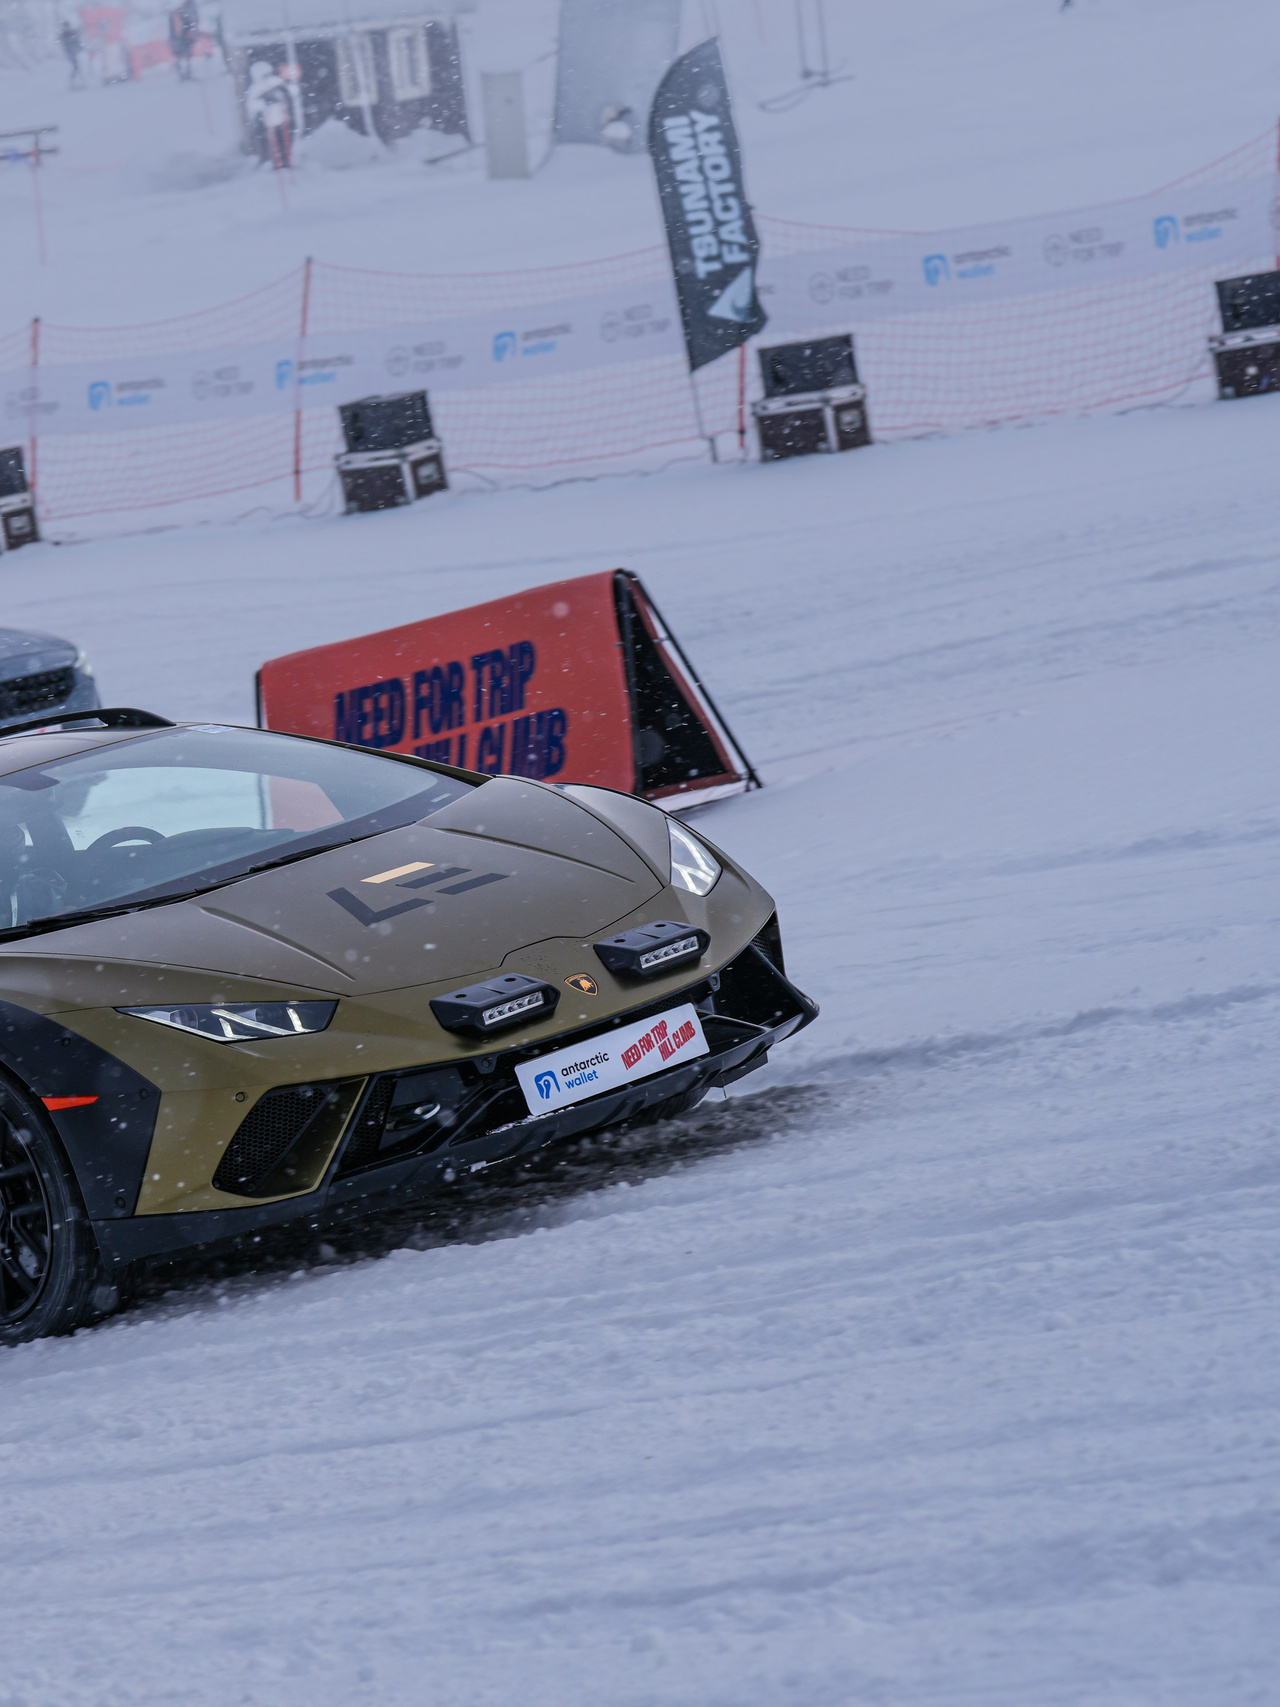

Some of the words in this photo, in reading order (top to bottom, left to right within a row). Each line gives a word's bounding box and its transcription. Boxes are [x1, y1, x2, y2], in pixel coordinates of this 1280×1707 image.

[662, 115, 724, 280] TSUNAMI
[690, 109, 751, 265] FACTORY
[335, 677, 405, 750] NEED
[412, 661, 465, 740] FOR
[470, 640, 536, 722] TRIP
[561, 1051, 610, 1077] antarctic
[620, 1043, 642, 1071] NEED
[637, 1032, 656, 1056] FOR
[650, 1019, 668, 1045] TRIP
[657, 1037, 677, 1062] HILL
[671, 1020, 696, 1050] CLIMB
[564, 1069, 599, 1090] wallet
